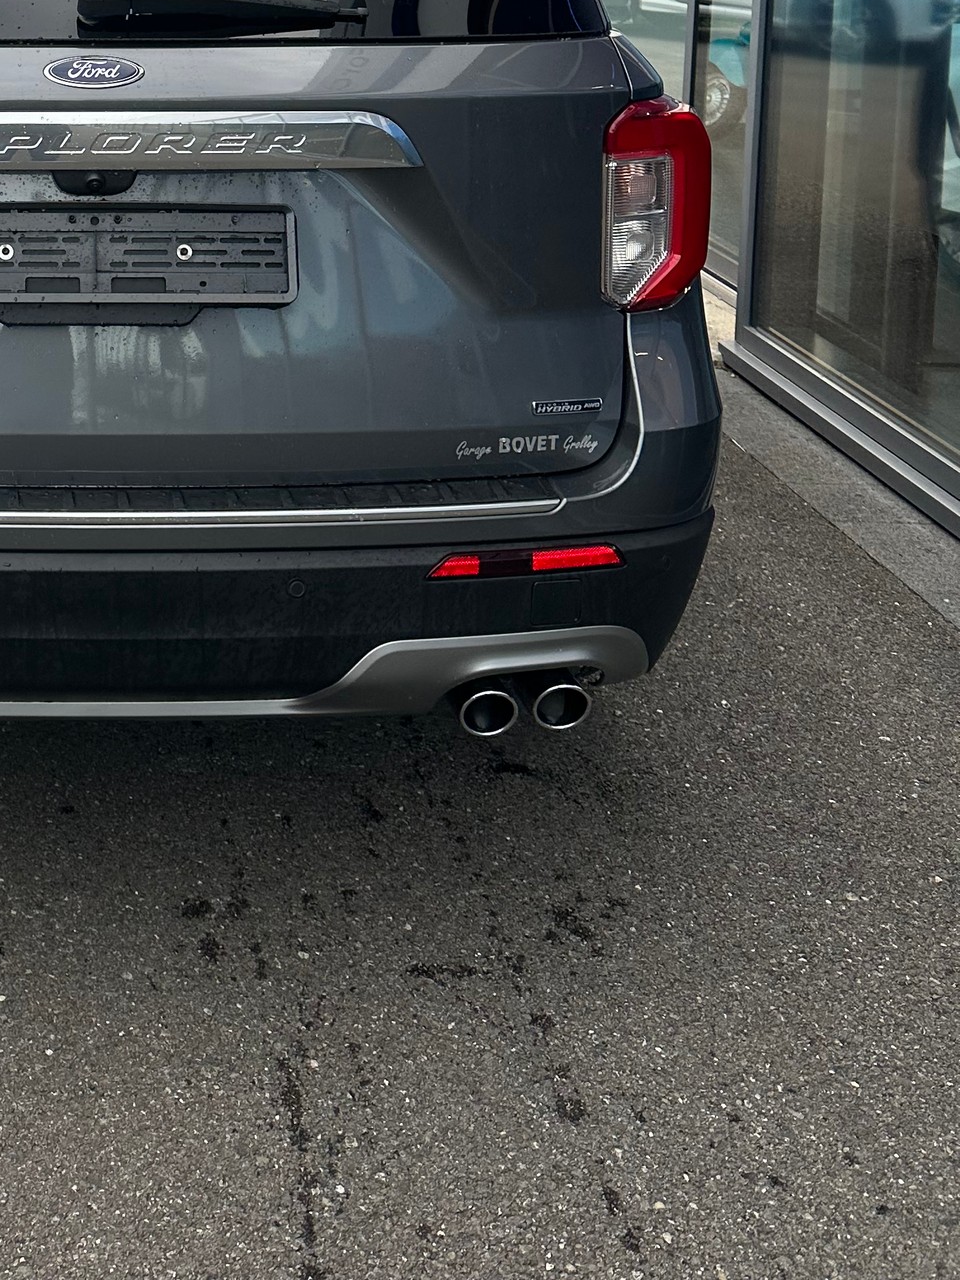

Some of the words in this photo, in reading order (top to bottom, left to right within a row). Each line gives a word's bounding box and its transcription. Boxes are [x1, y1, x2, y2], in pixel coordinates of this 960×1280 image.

[67, 60, 121, 79] Ford
[537, 404, 583, 413] HYBRID
[455, 440, 492, 460] Garage
[498, 434, 560, 454] BOVET
[563, 434, 599, 454] Grolley
